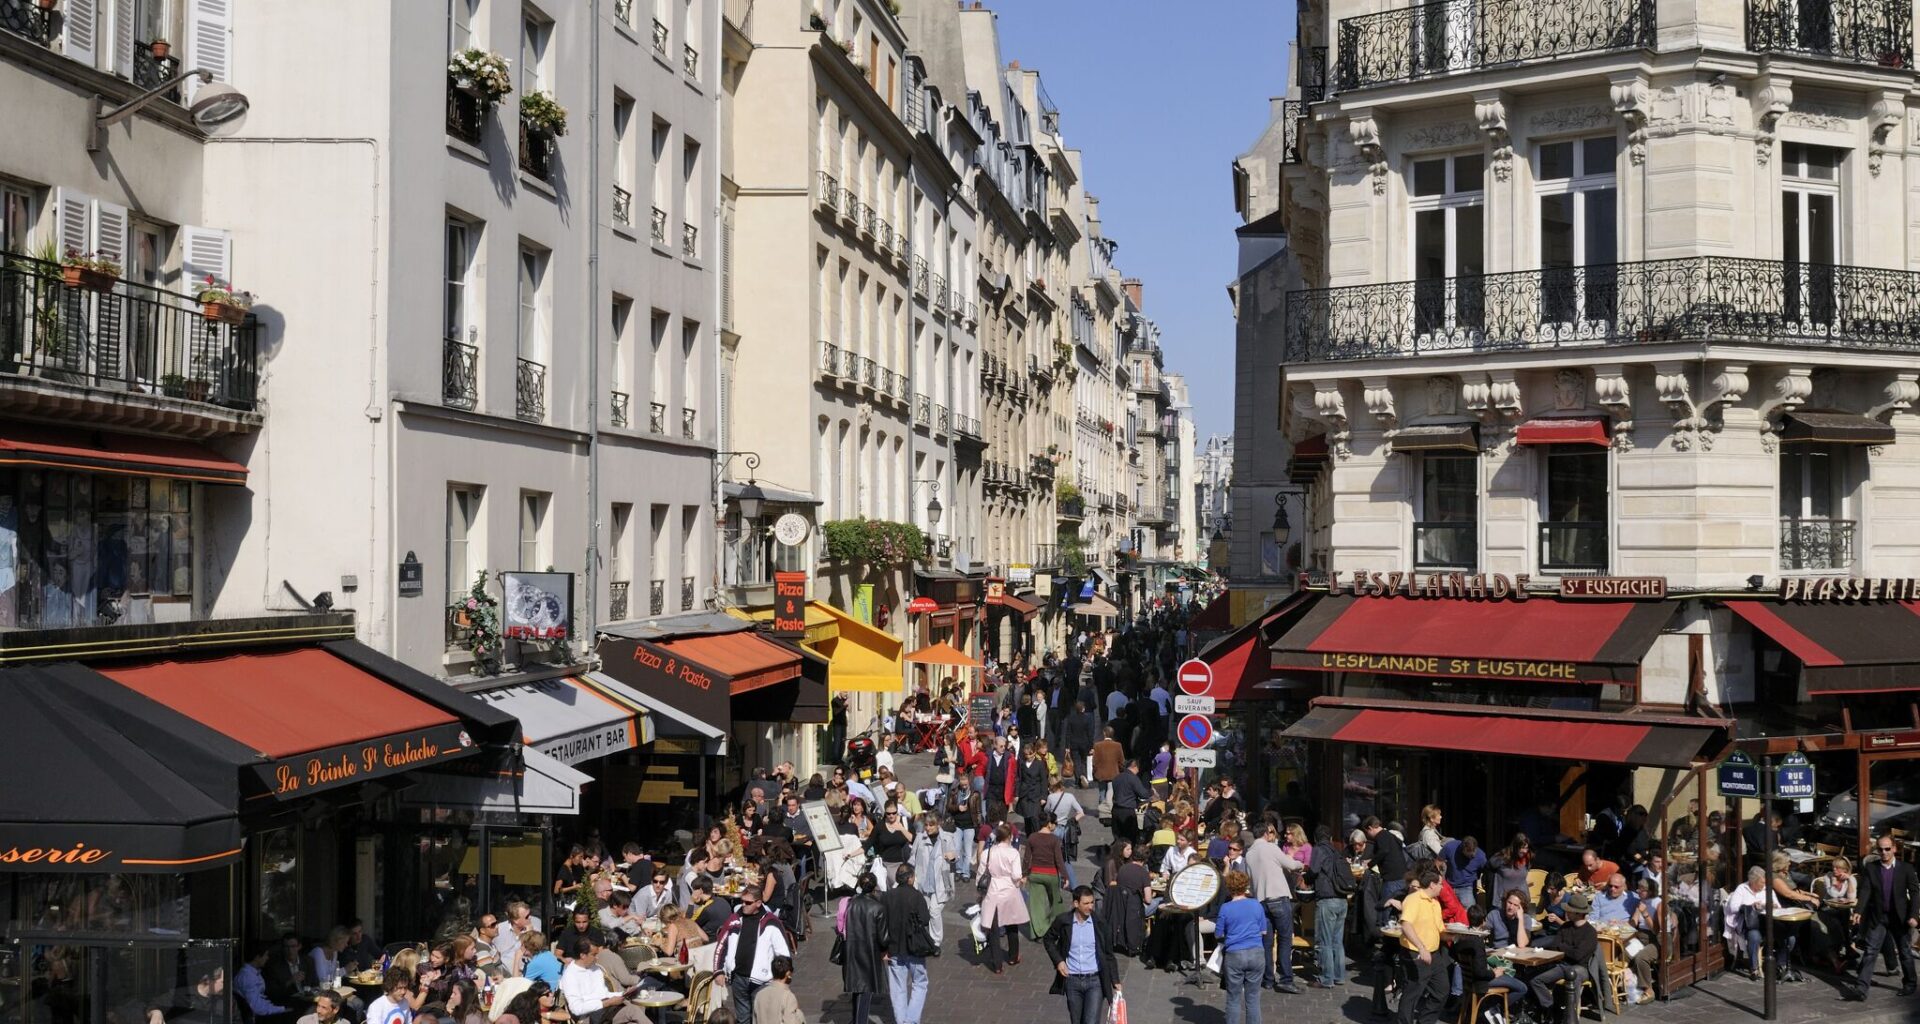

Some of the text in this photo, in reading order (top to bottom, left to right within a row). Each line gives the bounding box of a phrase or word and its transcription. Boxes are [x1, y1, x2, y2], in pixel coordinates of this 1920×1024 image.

[778, 582, 804, 596] Pizza
[1586, 579, 1660, 595] EUSTACHE
[1782, 577, 1920, 600] BRASSERIE
[785, 600, 795, 614] &
[776, 617, 804, 631] Pasta
[633, 646, 712, 690] Pizza & Pasta
[1322, 653, 1438, 673] L'ESPLANADE
[1477, 662, 1577, 679] EUSTACHE
[606, 728, 625, 747] BAR
[276, 765, 300, 793] La
[307, 754, 357, 786] Pointe
[383, 736, 438, 768] Eustache
[1788, 772, 1804, 780] RUE
[1780, 785, 1812, 793] TURBIGO
[0, 840, 112, 864] serie
